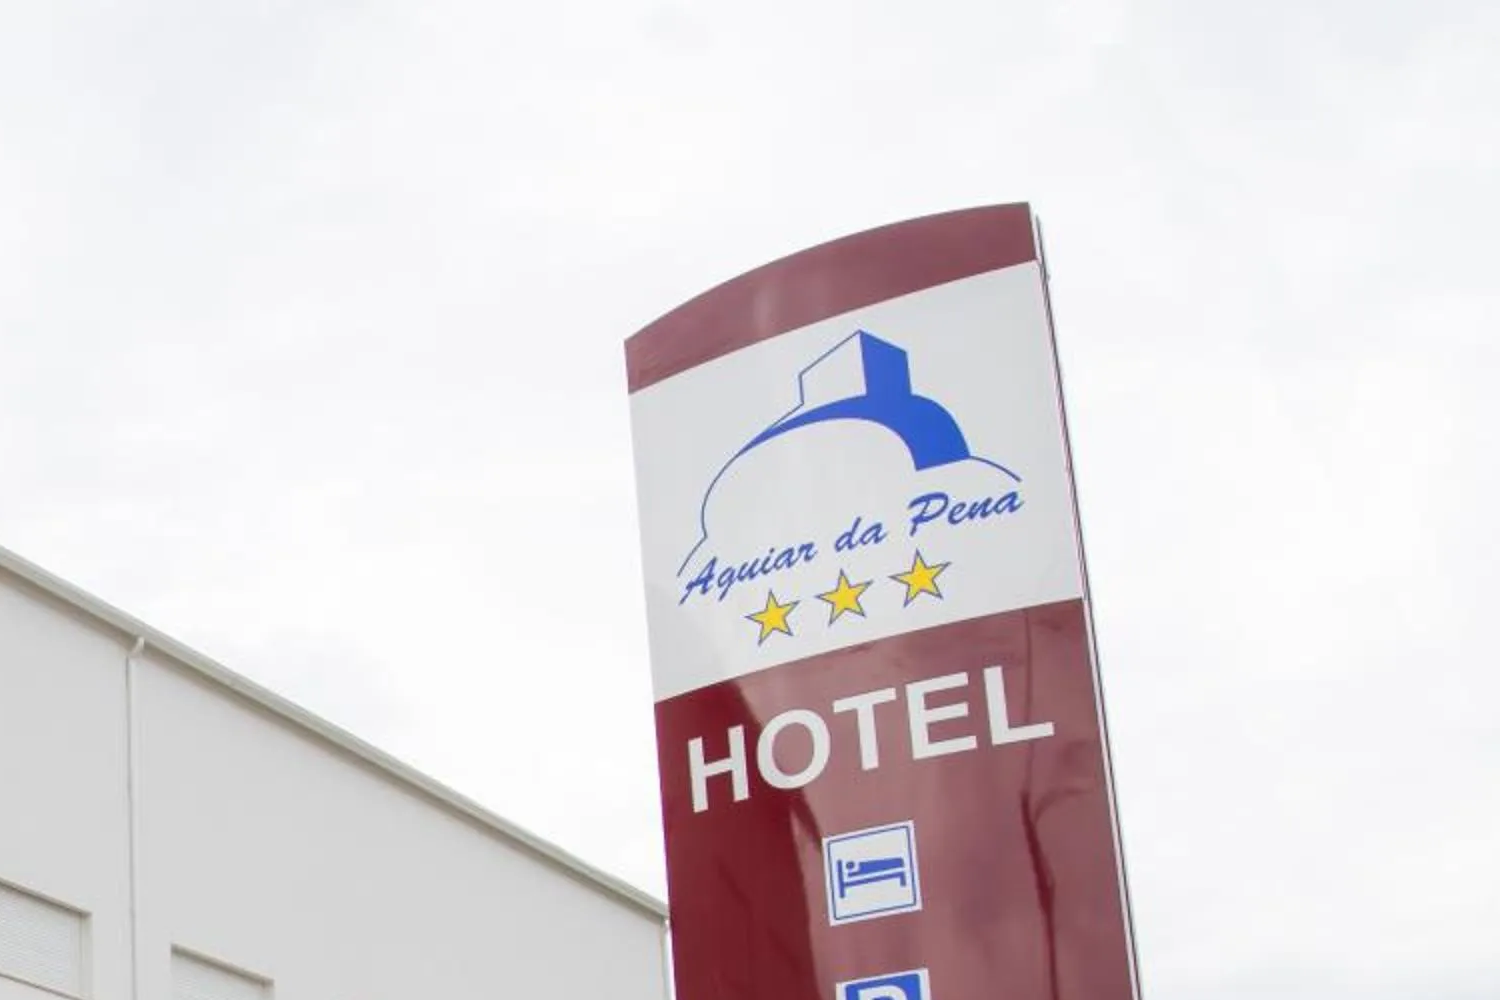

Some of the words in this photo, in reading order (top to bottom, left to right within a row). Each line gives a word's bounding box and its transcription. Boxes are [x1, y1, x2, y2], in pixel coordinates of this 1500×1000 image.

[679, 541, 817, 605] Aguiar
[834, 516, 888, 552] da
[908, 489, 1025, 537] Pena
[687, 665, 1056, 813] HOTEL
